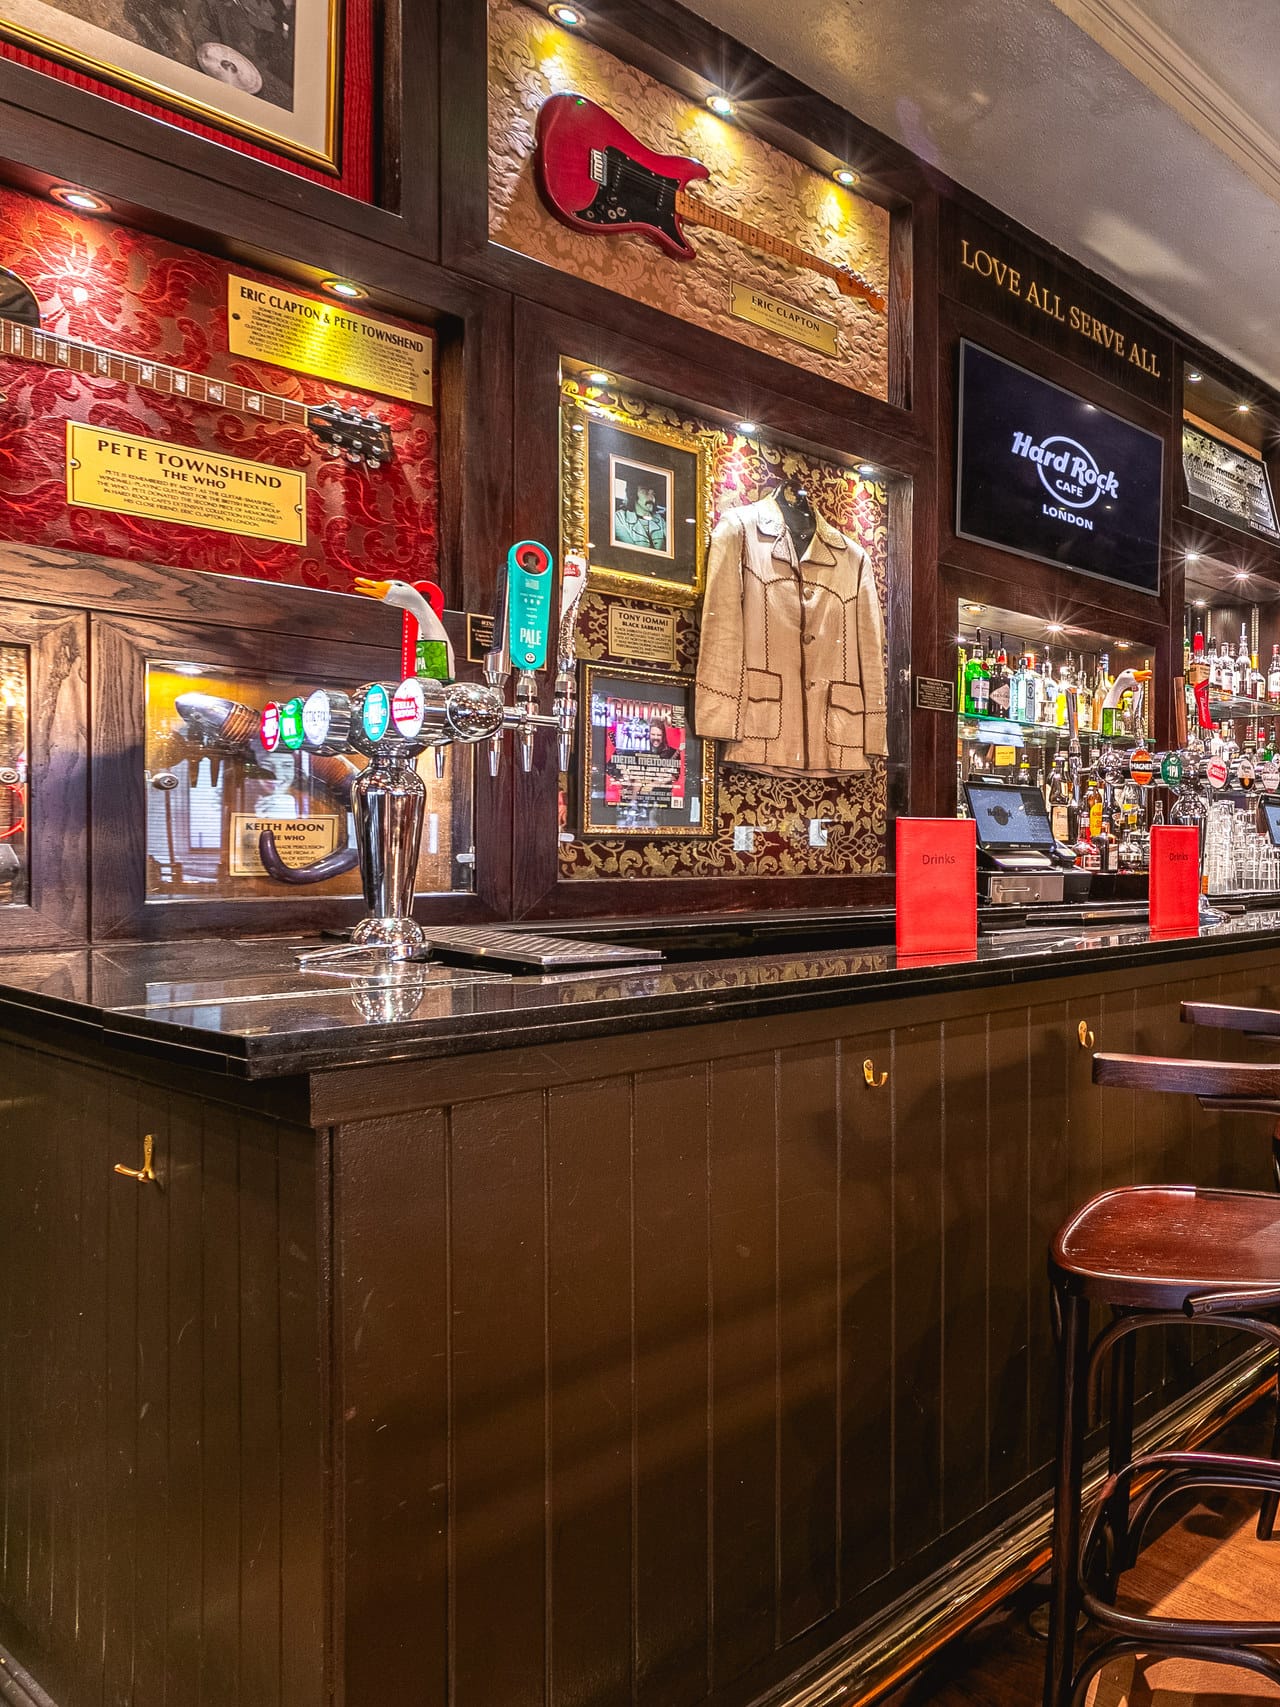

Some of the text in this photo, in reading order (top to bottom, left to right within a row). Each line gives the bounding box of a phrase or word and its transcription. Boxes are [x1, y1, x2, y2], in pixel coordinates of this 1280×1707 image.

[752, 295, 774, 312] ERIC
[776, 306, 820, 332] CLAPTON
[961, 240, 1160, 378] LOVE ALL SERVE ALL
[240, 286, 266, 304] ERIC
[270, 296, 320, 322] CLAPTON
[324, 313, 330, 324] &
[334, 316, 358, 333] PETE
[361, 324, 424, 353] TOWNSHEND
[98, 440, 282, 488] PETE TOWNSHEND
[1011, 432, 1119, 499] Hard Rock
[162, 469, 226, 489] THE WHO
[1056, 480, 1084, 498] CAFE
[1042, 504, 1094, 530] LONDON
[618, 612, 668, 626] TONY IOMMI
[622, 620, 664, 632] BLACK SABBATH
[520, 628, 542, 646] PALE
[610, 755, 636, 764] METAL
[1169, 765, 1178, 778] IPA
[246, 822, 324, 832] KEITH MOON
[922, 854, 956, 865] Drinks
[1169, 852, 1188, 862] Drinks
